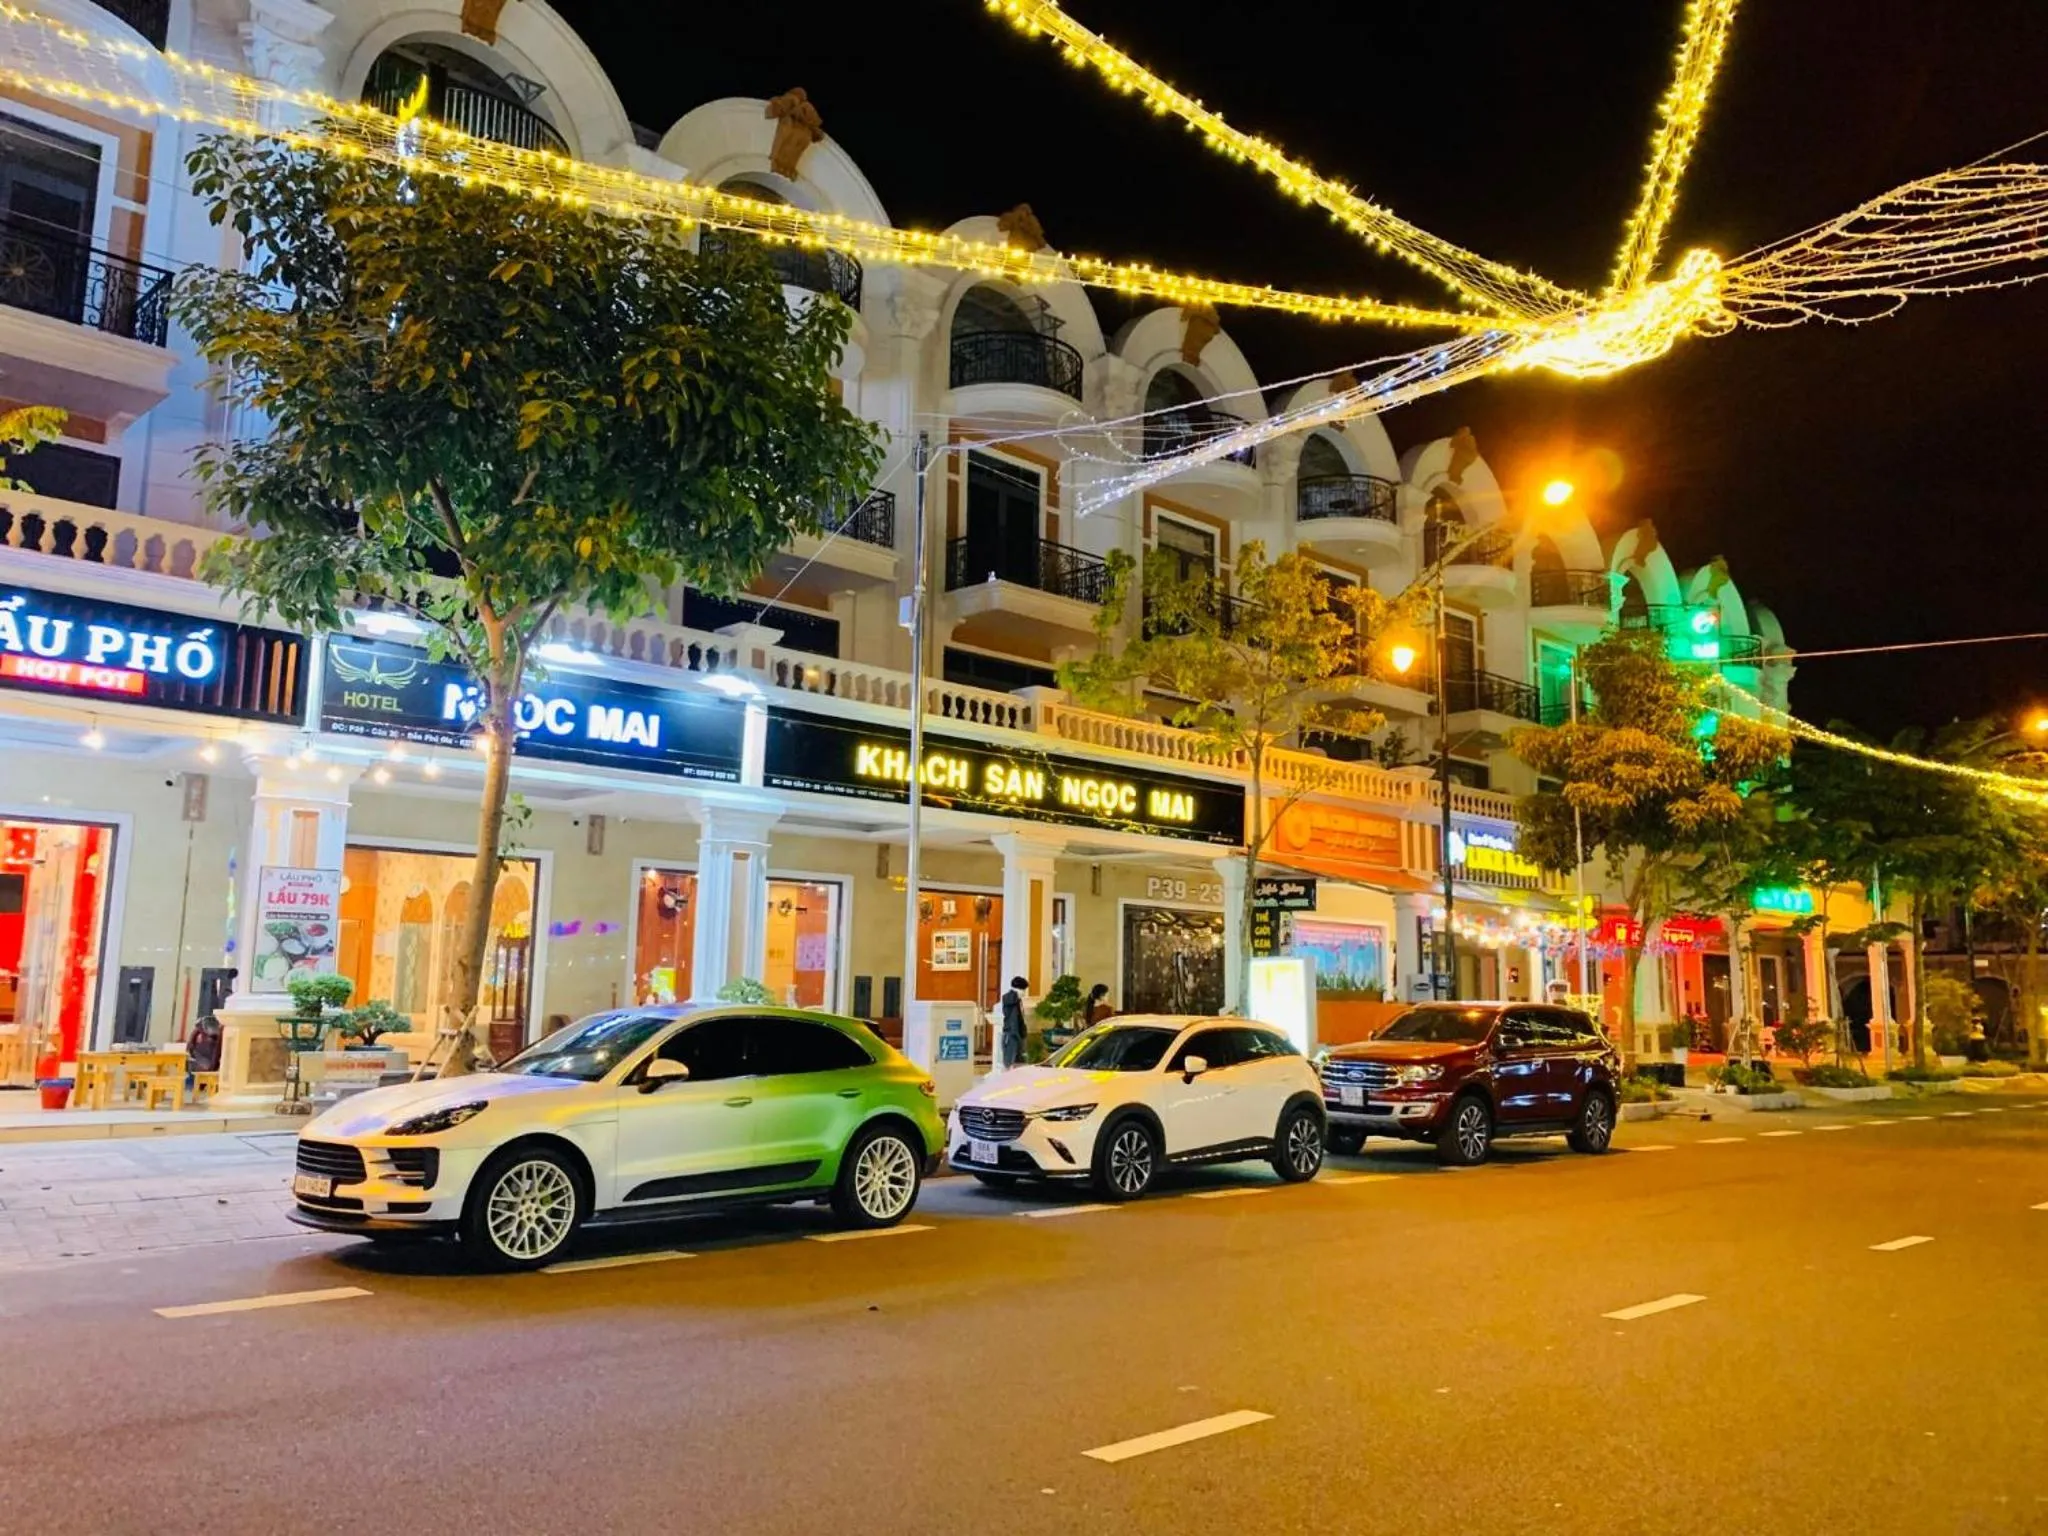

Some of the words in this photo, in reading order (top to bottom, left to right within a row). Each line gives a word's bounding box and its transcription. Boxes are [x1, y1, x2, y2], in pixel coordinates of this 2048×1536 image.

[85, 624, 214, 678] PHỐ
[16, 657, 71, 681] HOT
[79, 668, 130, 689] POT
[343, 691, 403, 712] HOTEL
[442, 683, 576, 738] NỌC
[587, 705, 660, 748] MAI
[985, 765, 1044, 803] SẠN
[1062, 778, 1137, 816] NGỌC
[1150, 790, 1195, 822] MAI
[300, 892, 331, 906] 79K
